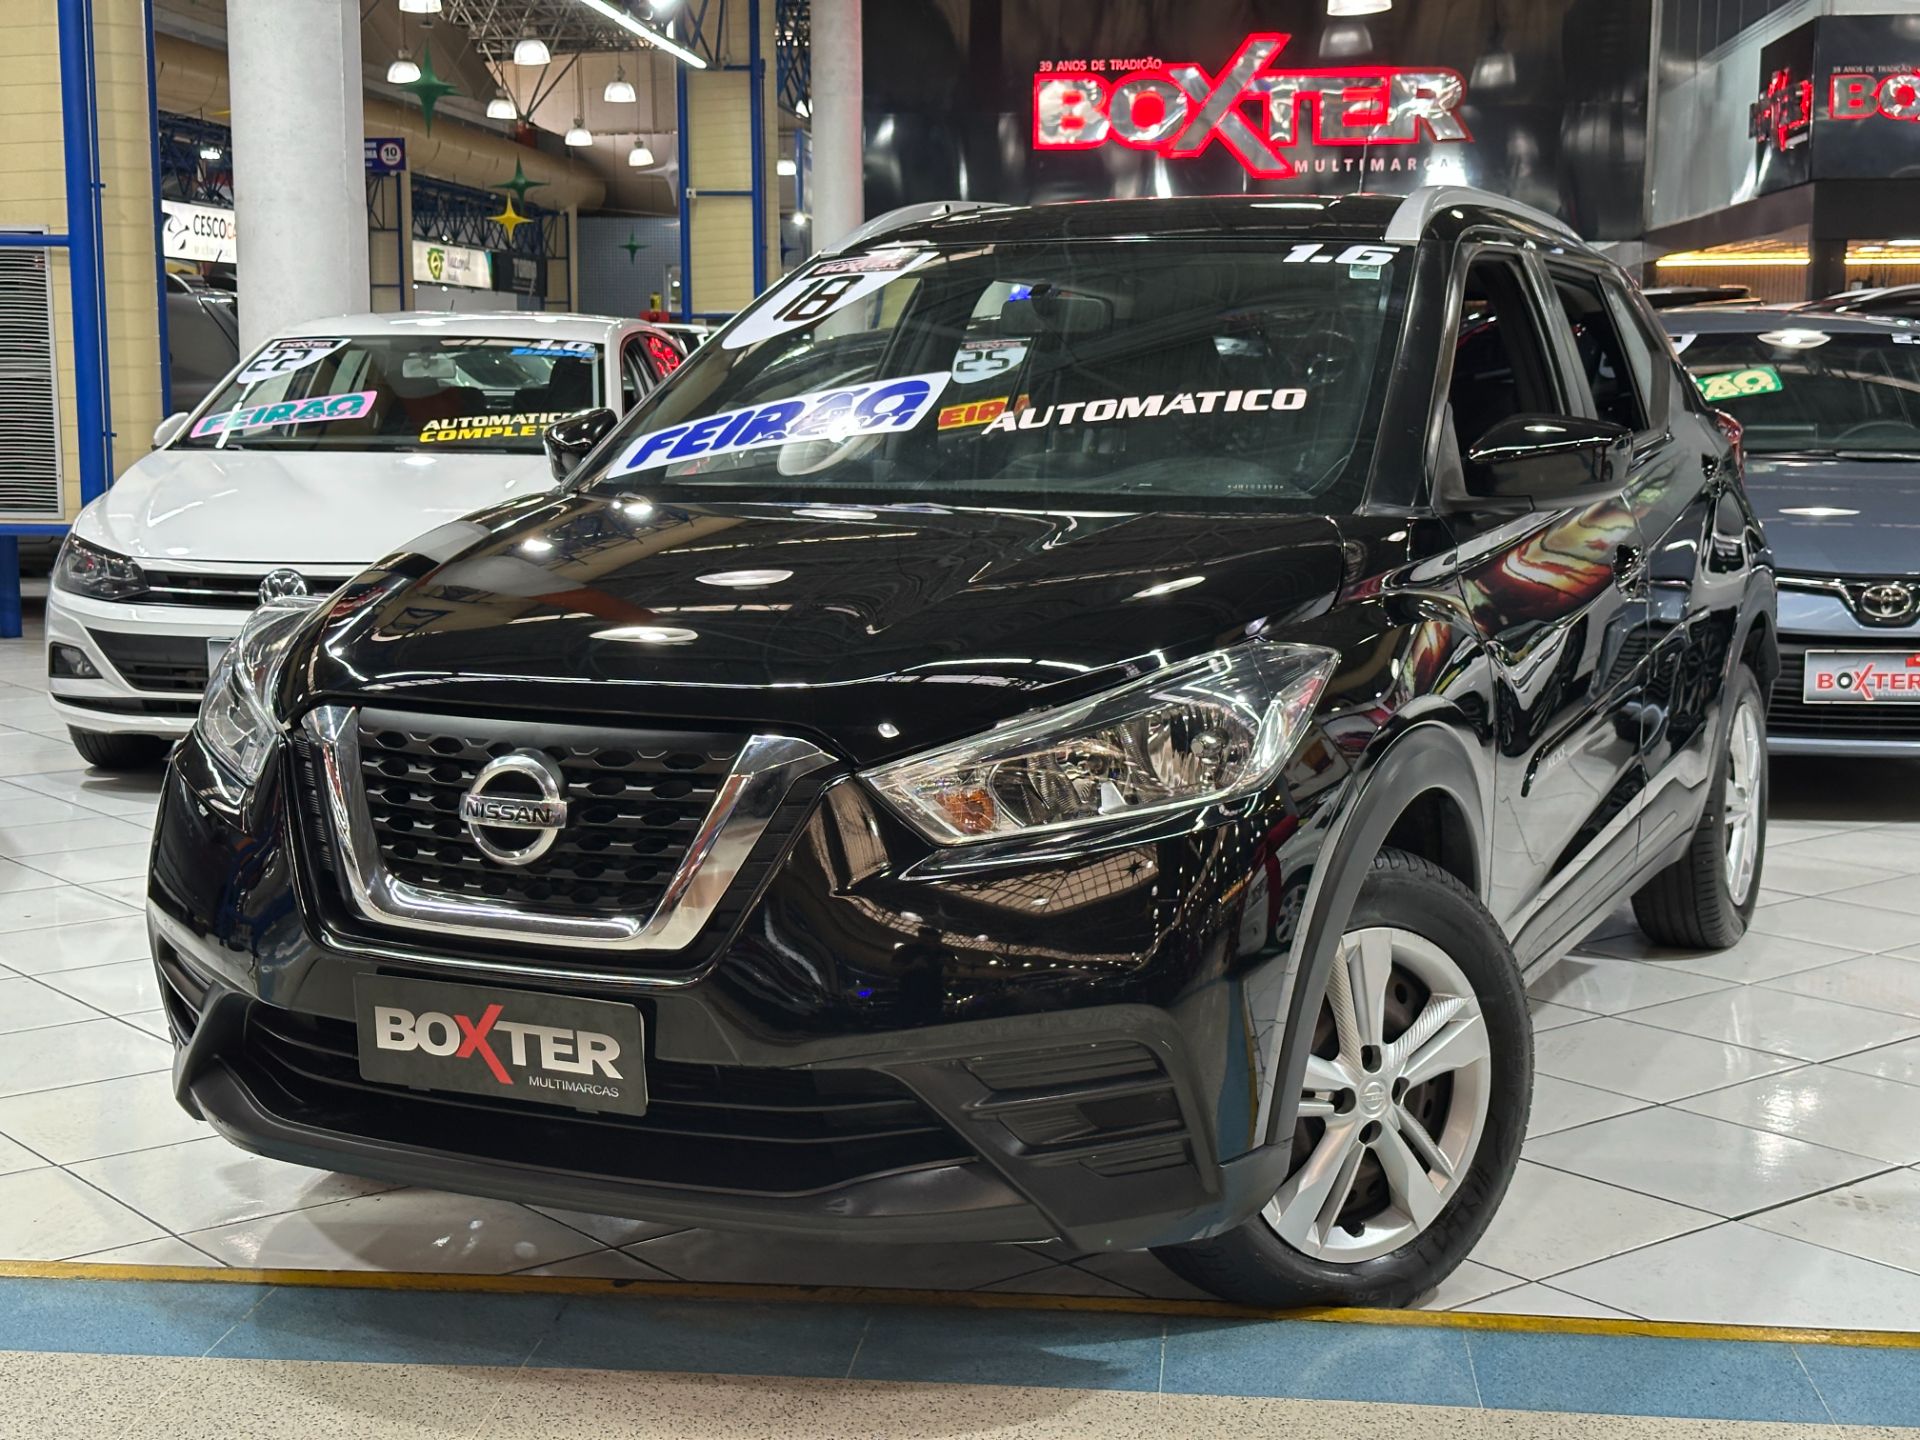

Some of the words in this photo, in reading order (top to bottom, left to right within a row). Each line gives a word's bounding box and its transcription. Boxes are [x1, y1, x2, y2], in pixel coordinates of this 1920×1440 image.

[1039, 61, 1053, 72] 39
[1056, 61, 1087, 71] ANOS
[1091, 60, 1105, 71] DE
[1110, 56, 1162, 71] TRADIÇÃO
[1033, 32, 1476, 180] BOXTER
[1828, 72, 1920, 122] BO
[383, 146, 398, 158] 10
[1282, 243, 1401, 266] 1.6
[772, 274, 866, 323] 18
[246, 349, 313, 373] 22
[956, 350, 1011, 373] 25
[200, 394, 365, 433] FEIRÃO
[626, 380, 931, 469] FEIRÃO
[466, 802, 552, 823] NISSAN
[374, 1003, 624, 1086] BOXTER
[528, 1075, 620, 1098] MULTIMARCAS
